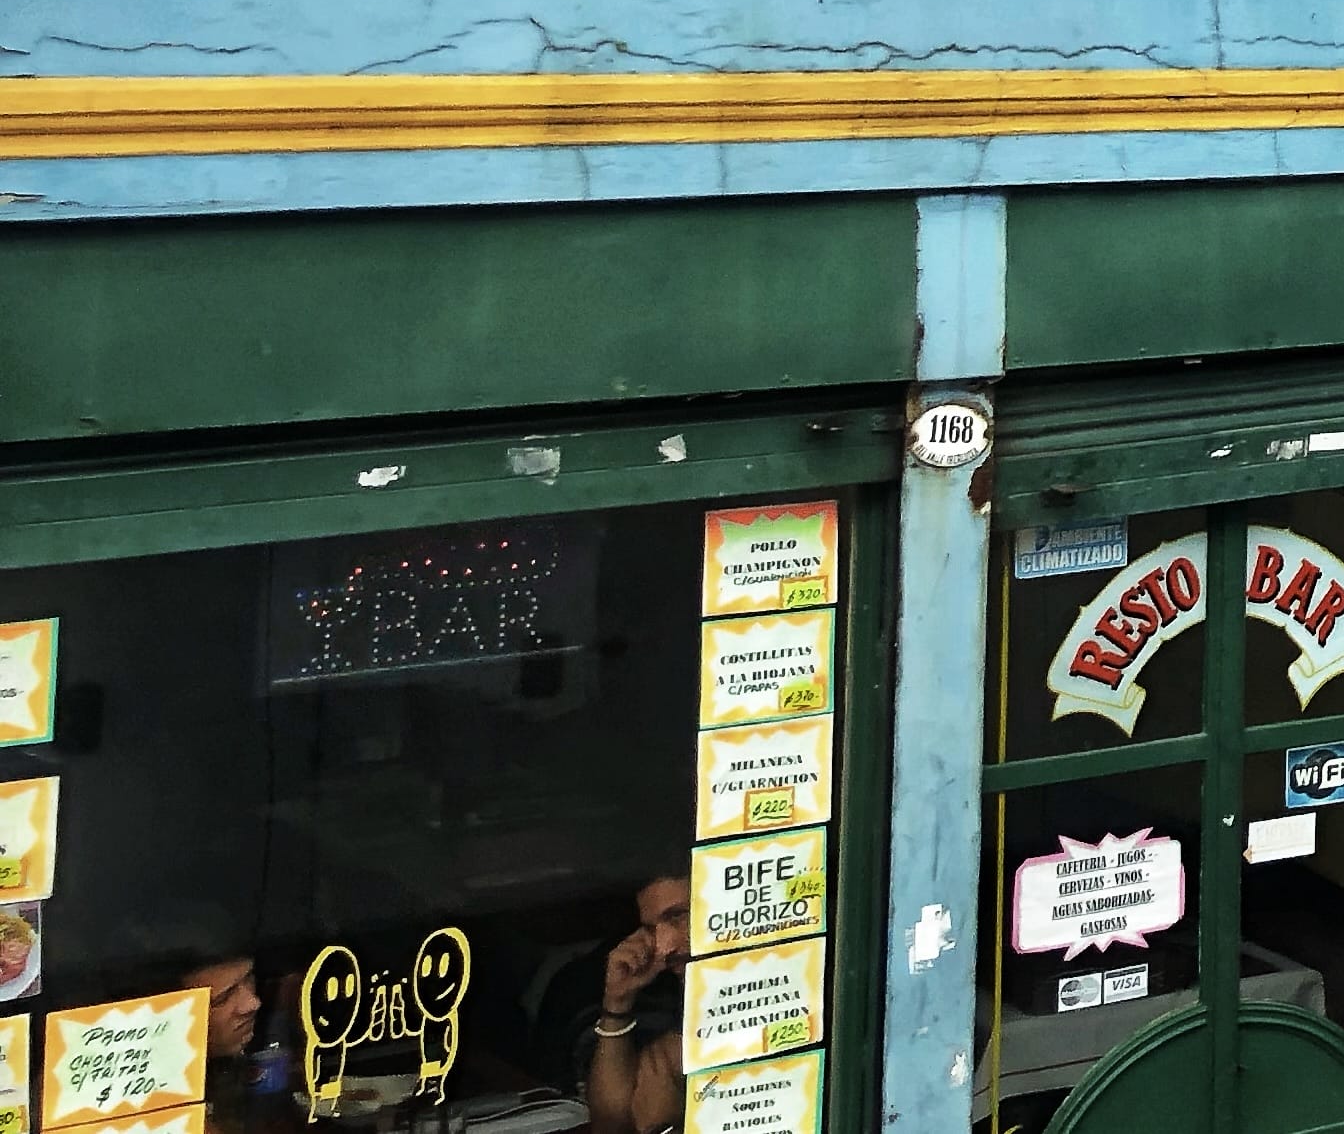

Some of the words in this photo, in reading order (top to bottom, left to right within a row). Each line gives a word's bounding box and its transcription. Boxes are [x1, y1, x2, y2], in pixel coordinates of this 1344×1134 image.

[928, 414, 974, 444] 1168
[750, 539, 797, 553] POLLO
[723, 555, 821, 575] CHAMPIGNON
[1021, 543, 1123, 573] CLIMATIZADO
[372, 589, 542, 663] BAR
[1069, 557, 1203, 690] RESTO
[720, 646, 813, 666] COSTILLITAS
[730, 672, 747, 684] LA
[752, 664, 815, 681] RIOJANA
[727, 681, 780, 696] C/PAPAS
[729, 754, 803, 772] MILANESA
[711, 772, 820, 795] C/GUARNICION
[724, 855, 796, 891] BIFE
[1056, 855, 1107, 877] CAFETERIA
[1117, 848, 1147, 868] JUGOS
[1058, 875, 1105, 896] CERVEZAS
[1114, 869, 1143, 886] VINOS
[744, 885, 772, 906] DE
[708, 898, 809, 932] CHORIZO
[1052, 901, 1083, 919] AGUAS
[1080, 915, 1128, 936] GASEOSAS
[718, 975, 790, 999] SUPREMA
[1112, 975, 1141, 991] VISA
[706, 990, 801, 1019] NAPOLITANA
[718, 1079, 792, 1100] TALLARINES
[722, 1113, 782, 1132] RAVIOLES
